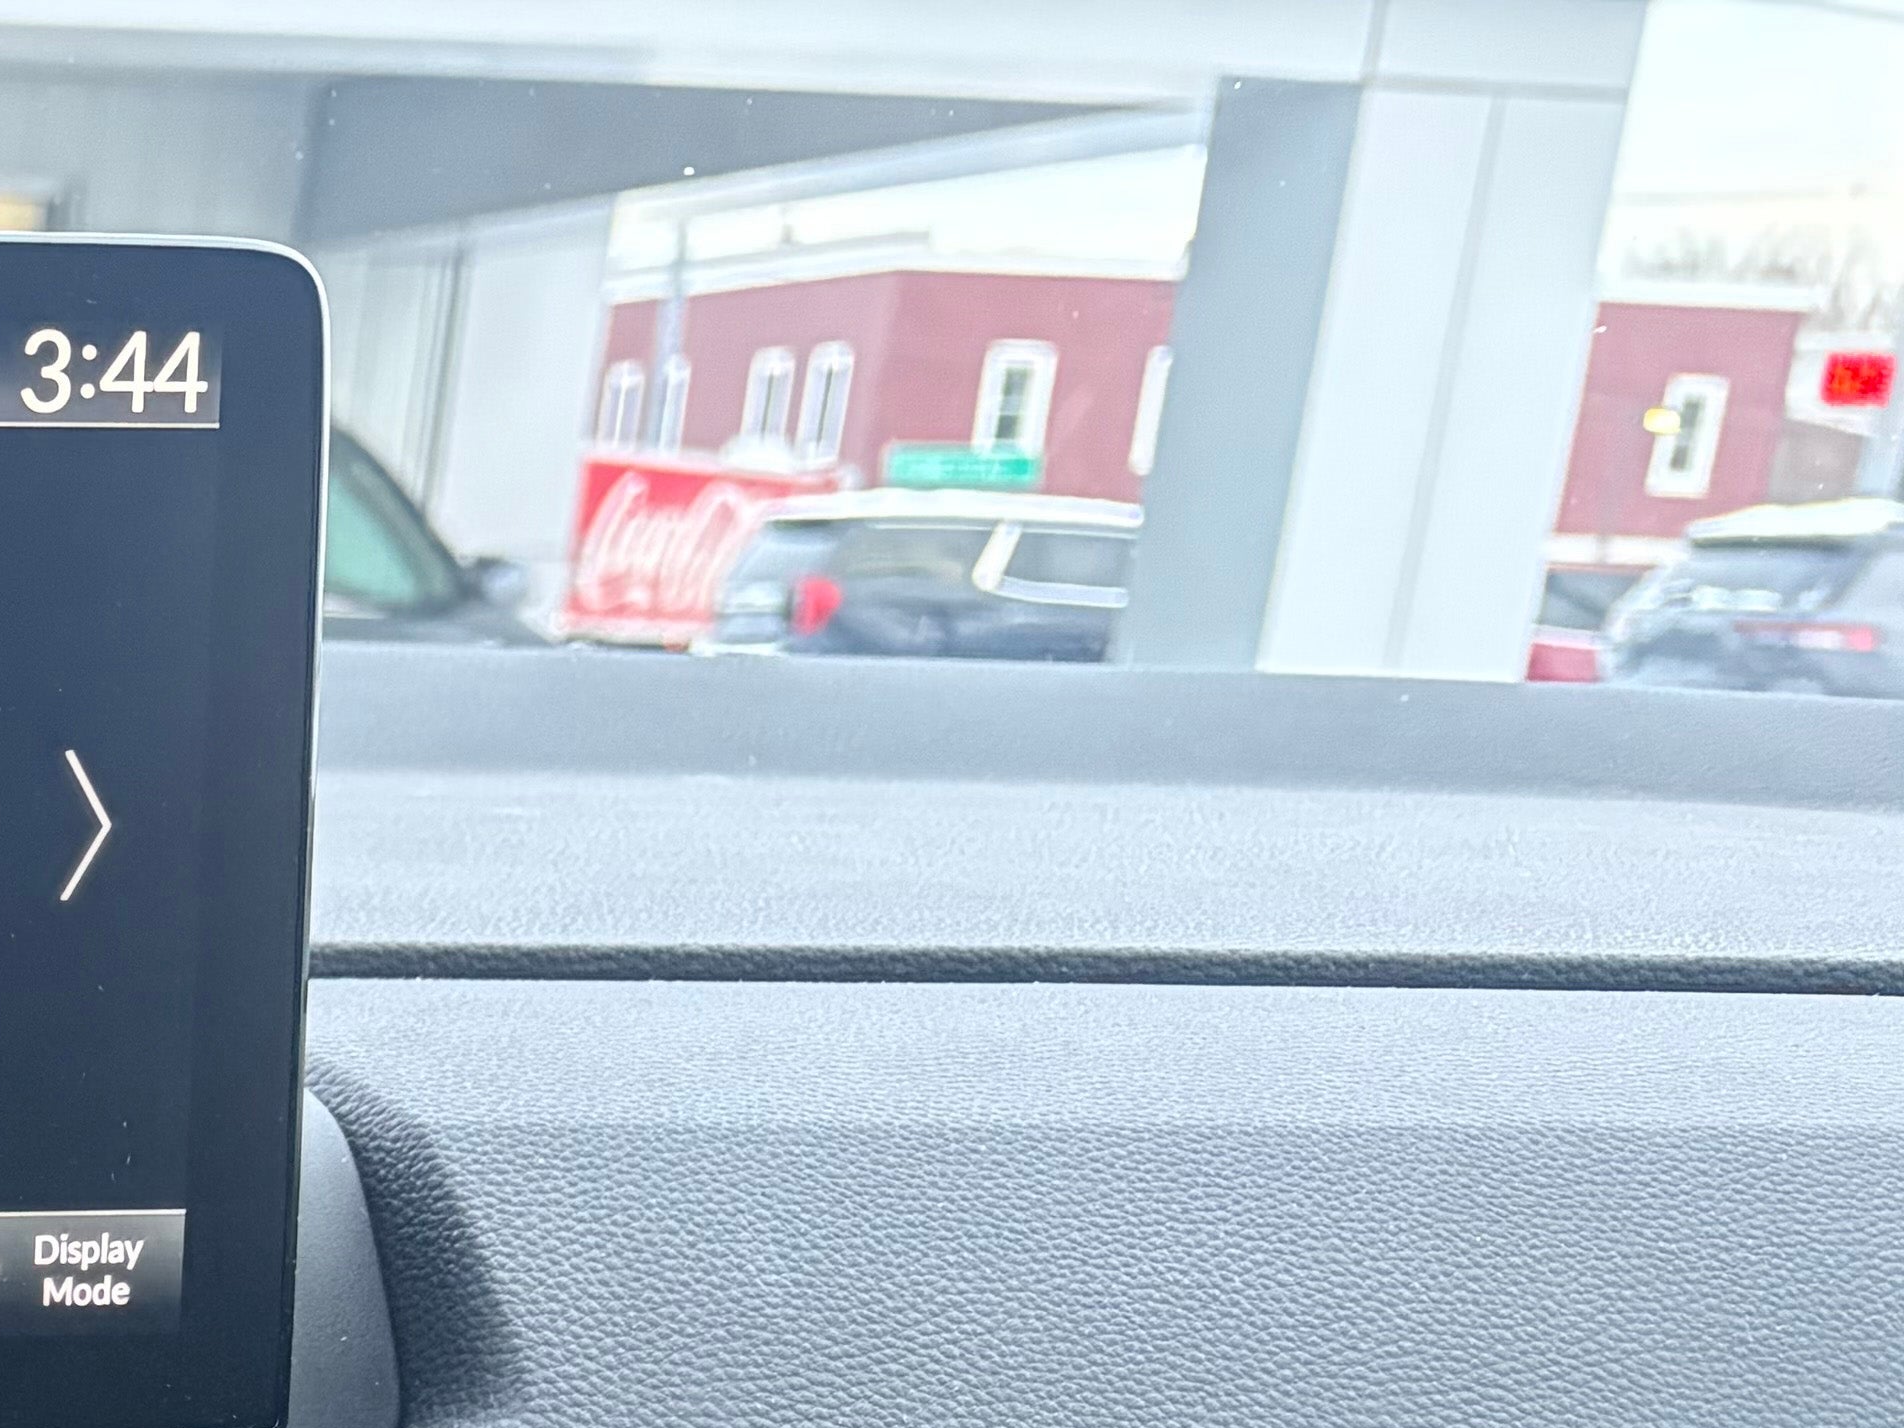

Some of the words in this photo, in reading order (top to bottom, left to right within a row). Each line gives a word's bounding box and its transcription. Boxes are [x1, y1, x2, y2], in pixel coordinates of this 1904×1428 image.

[20, 328, 209, 414] 3:44
[34, 1231, 145, 1271] Display
[42, 1274, 131, 1307] Mode
